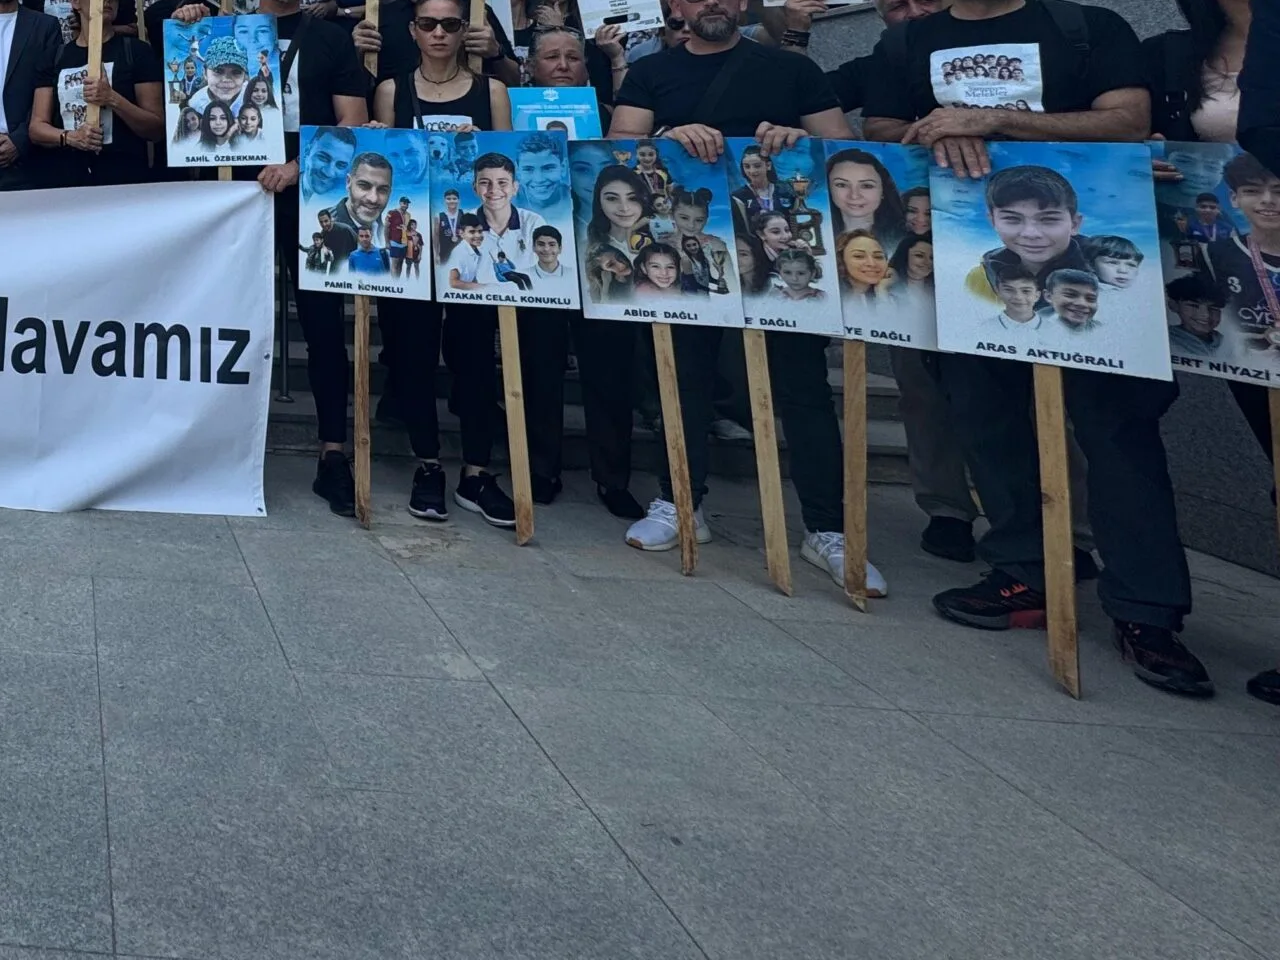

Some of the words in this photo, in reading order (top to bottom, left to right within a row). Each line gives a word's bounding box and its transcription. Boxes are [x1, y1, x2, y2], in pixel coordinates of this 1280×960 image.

[185, 155, 210, 163] SAHİL
[214, 154, 267, 162] ÖZBERKMAN
[324, 280, 353, 290] PAMİR
[358, 282, 404, 294] KONUKLU
[1227, 276, 1242, 293] 3
[443, 292, 483, 301] ATAKAN
[485, 294, 517, 303] CELAL
[520, 296, 571, 306] KONUKLU
[624, 308, 657, 318] ABİDE
[664, 311, 698, 321] DAĞLI
[760, 318, 797, 328] DAĞLI
[870, 329, 911, 342] DAĞLI
[976, 341, 1017, 355] ARAS
[1026, 347, 1124, 369] AKTUĞRALI
[1171, 354, 1203, 369] ERT
[1208, 358, 1270, 381] NİYAZİ
